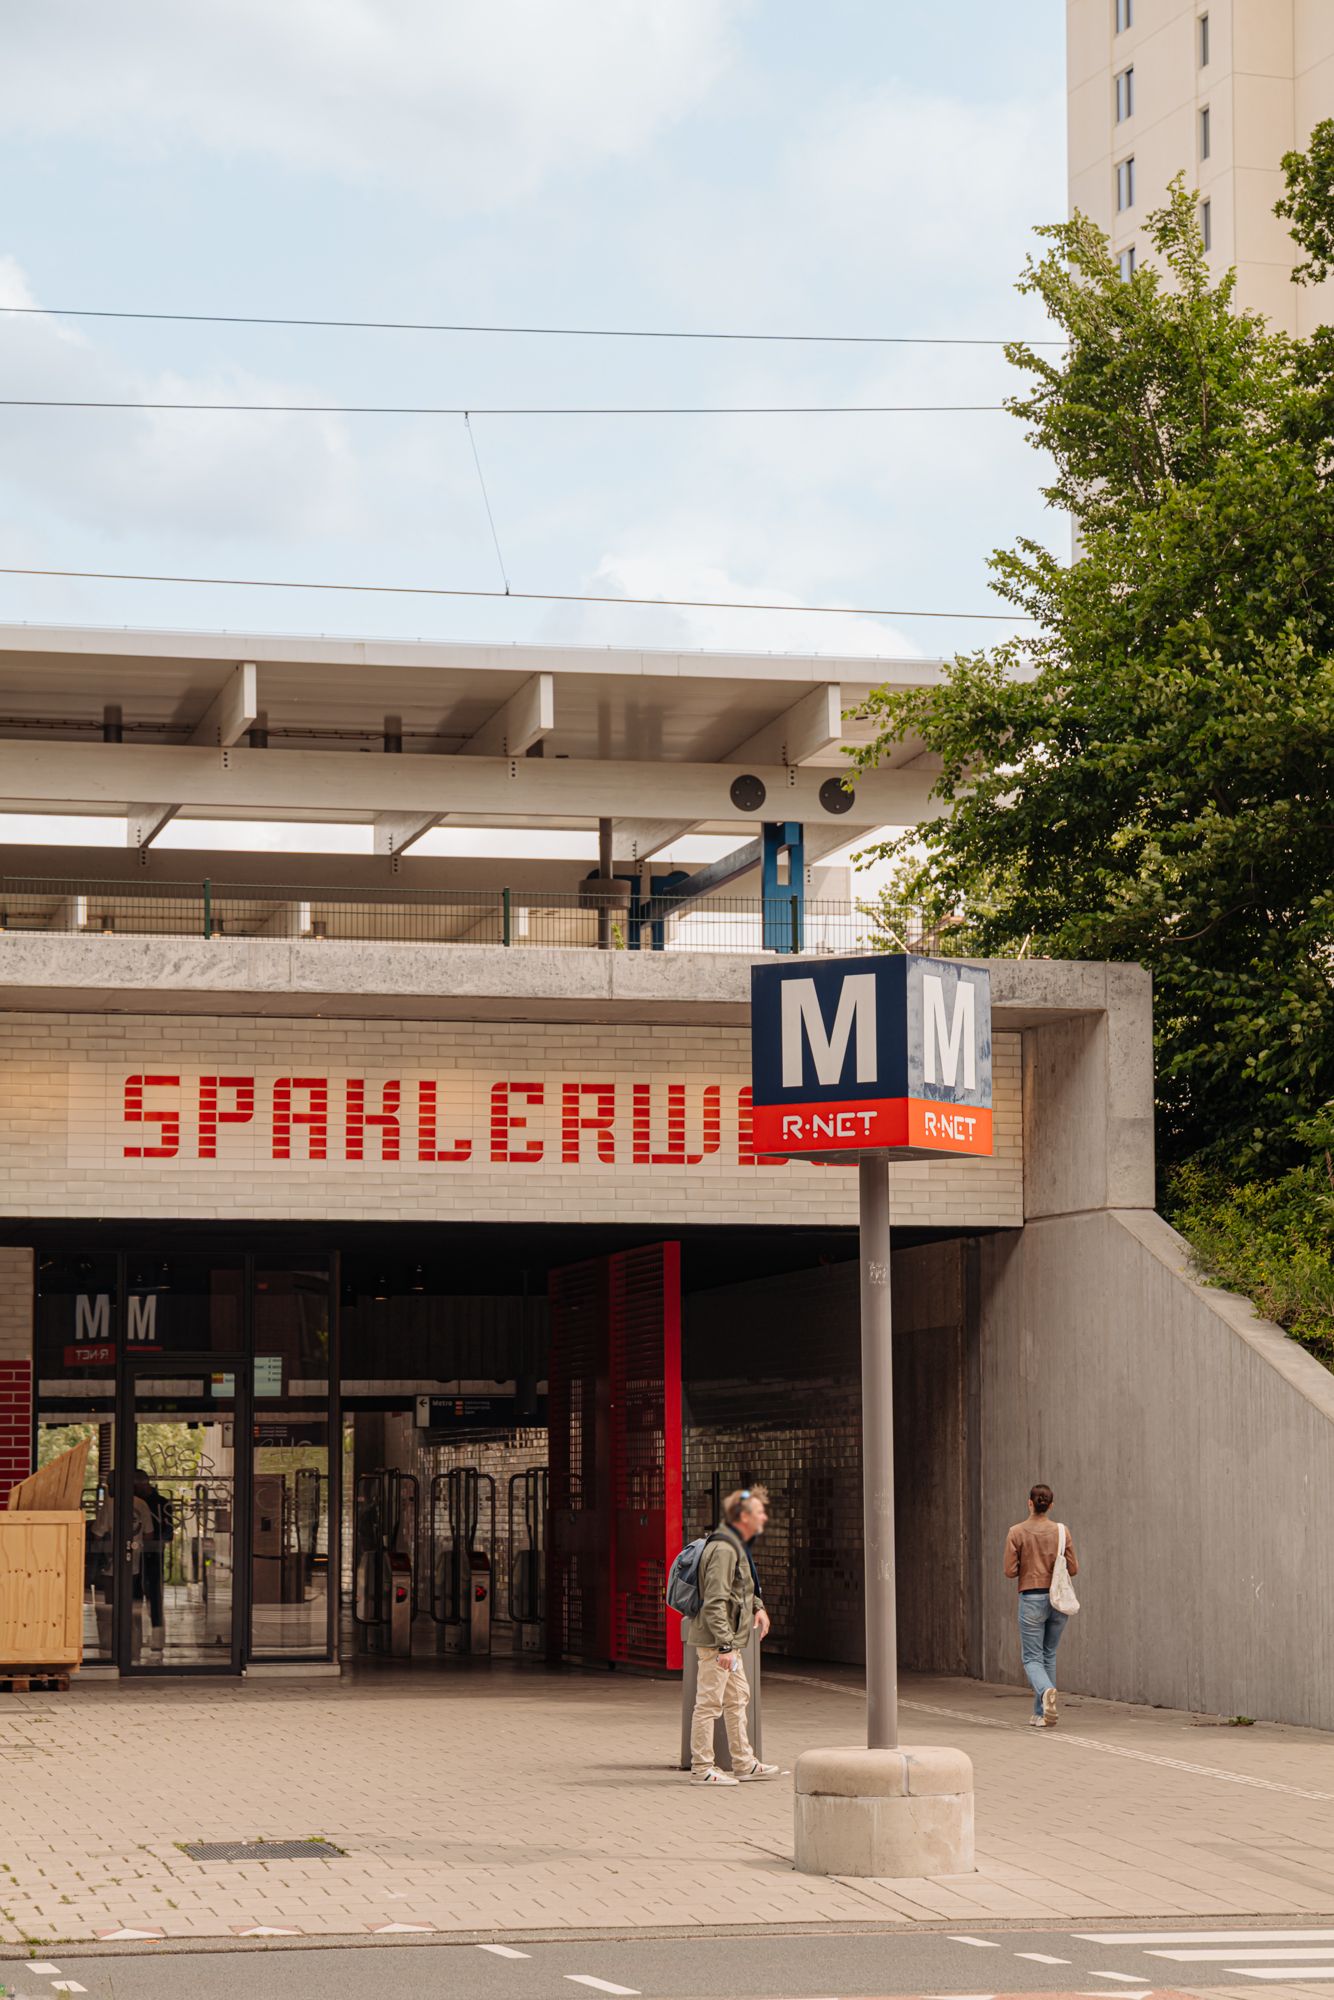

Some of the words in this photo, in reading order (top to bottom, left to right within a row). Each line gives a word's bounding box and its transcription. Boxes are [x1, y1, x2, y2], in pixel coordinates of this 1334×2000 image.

[780, 973, 878, 1088] M
[922, 974, 976, 1090] M
[124, 1075, 859, 1166] SPAKLERW
